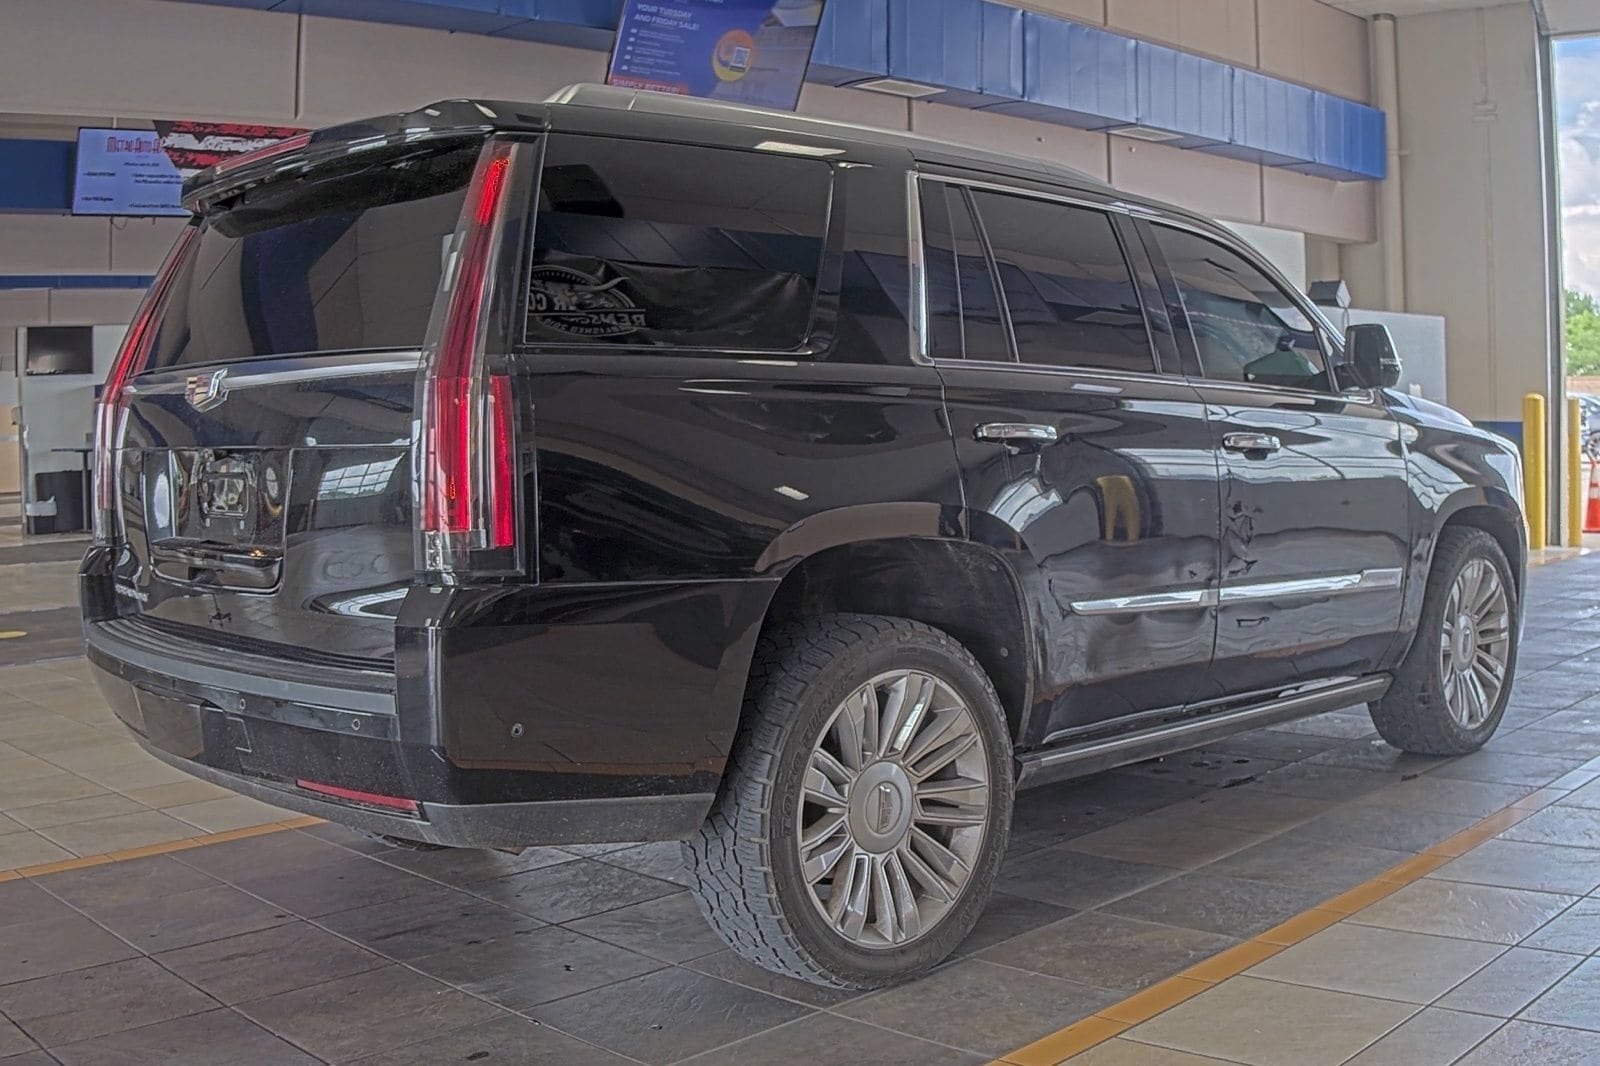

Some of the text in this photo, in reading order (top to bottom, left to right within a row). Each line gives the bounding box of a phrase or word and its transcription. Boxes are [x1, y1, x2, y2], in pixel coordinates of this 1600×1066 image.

[637, 3, 692, 18] YOUR TUESDAY
[634, 13, 651, 22] AND
[652, 15, 677, 26] FRIDAY
